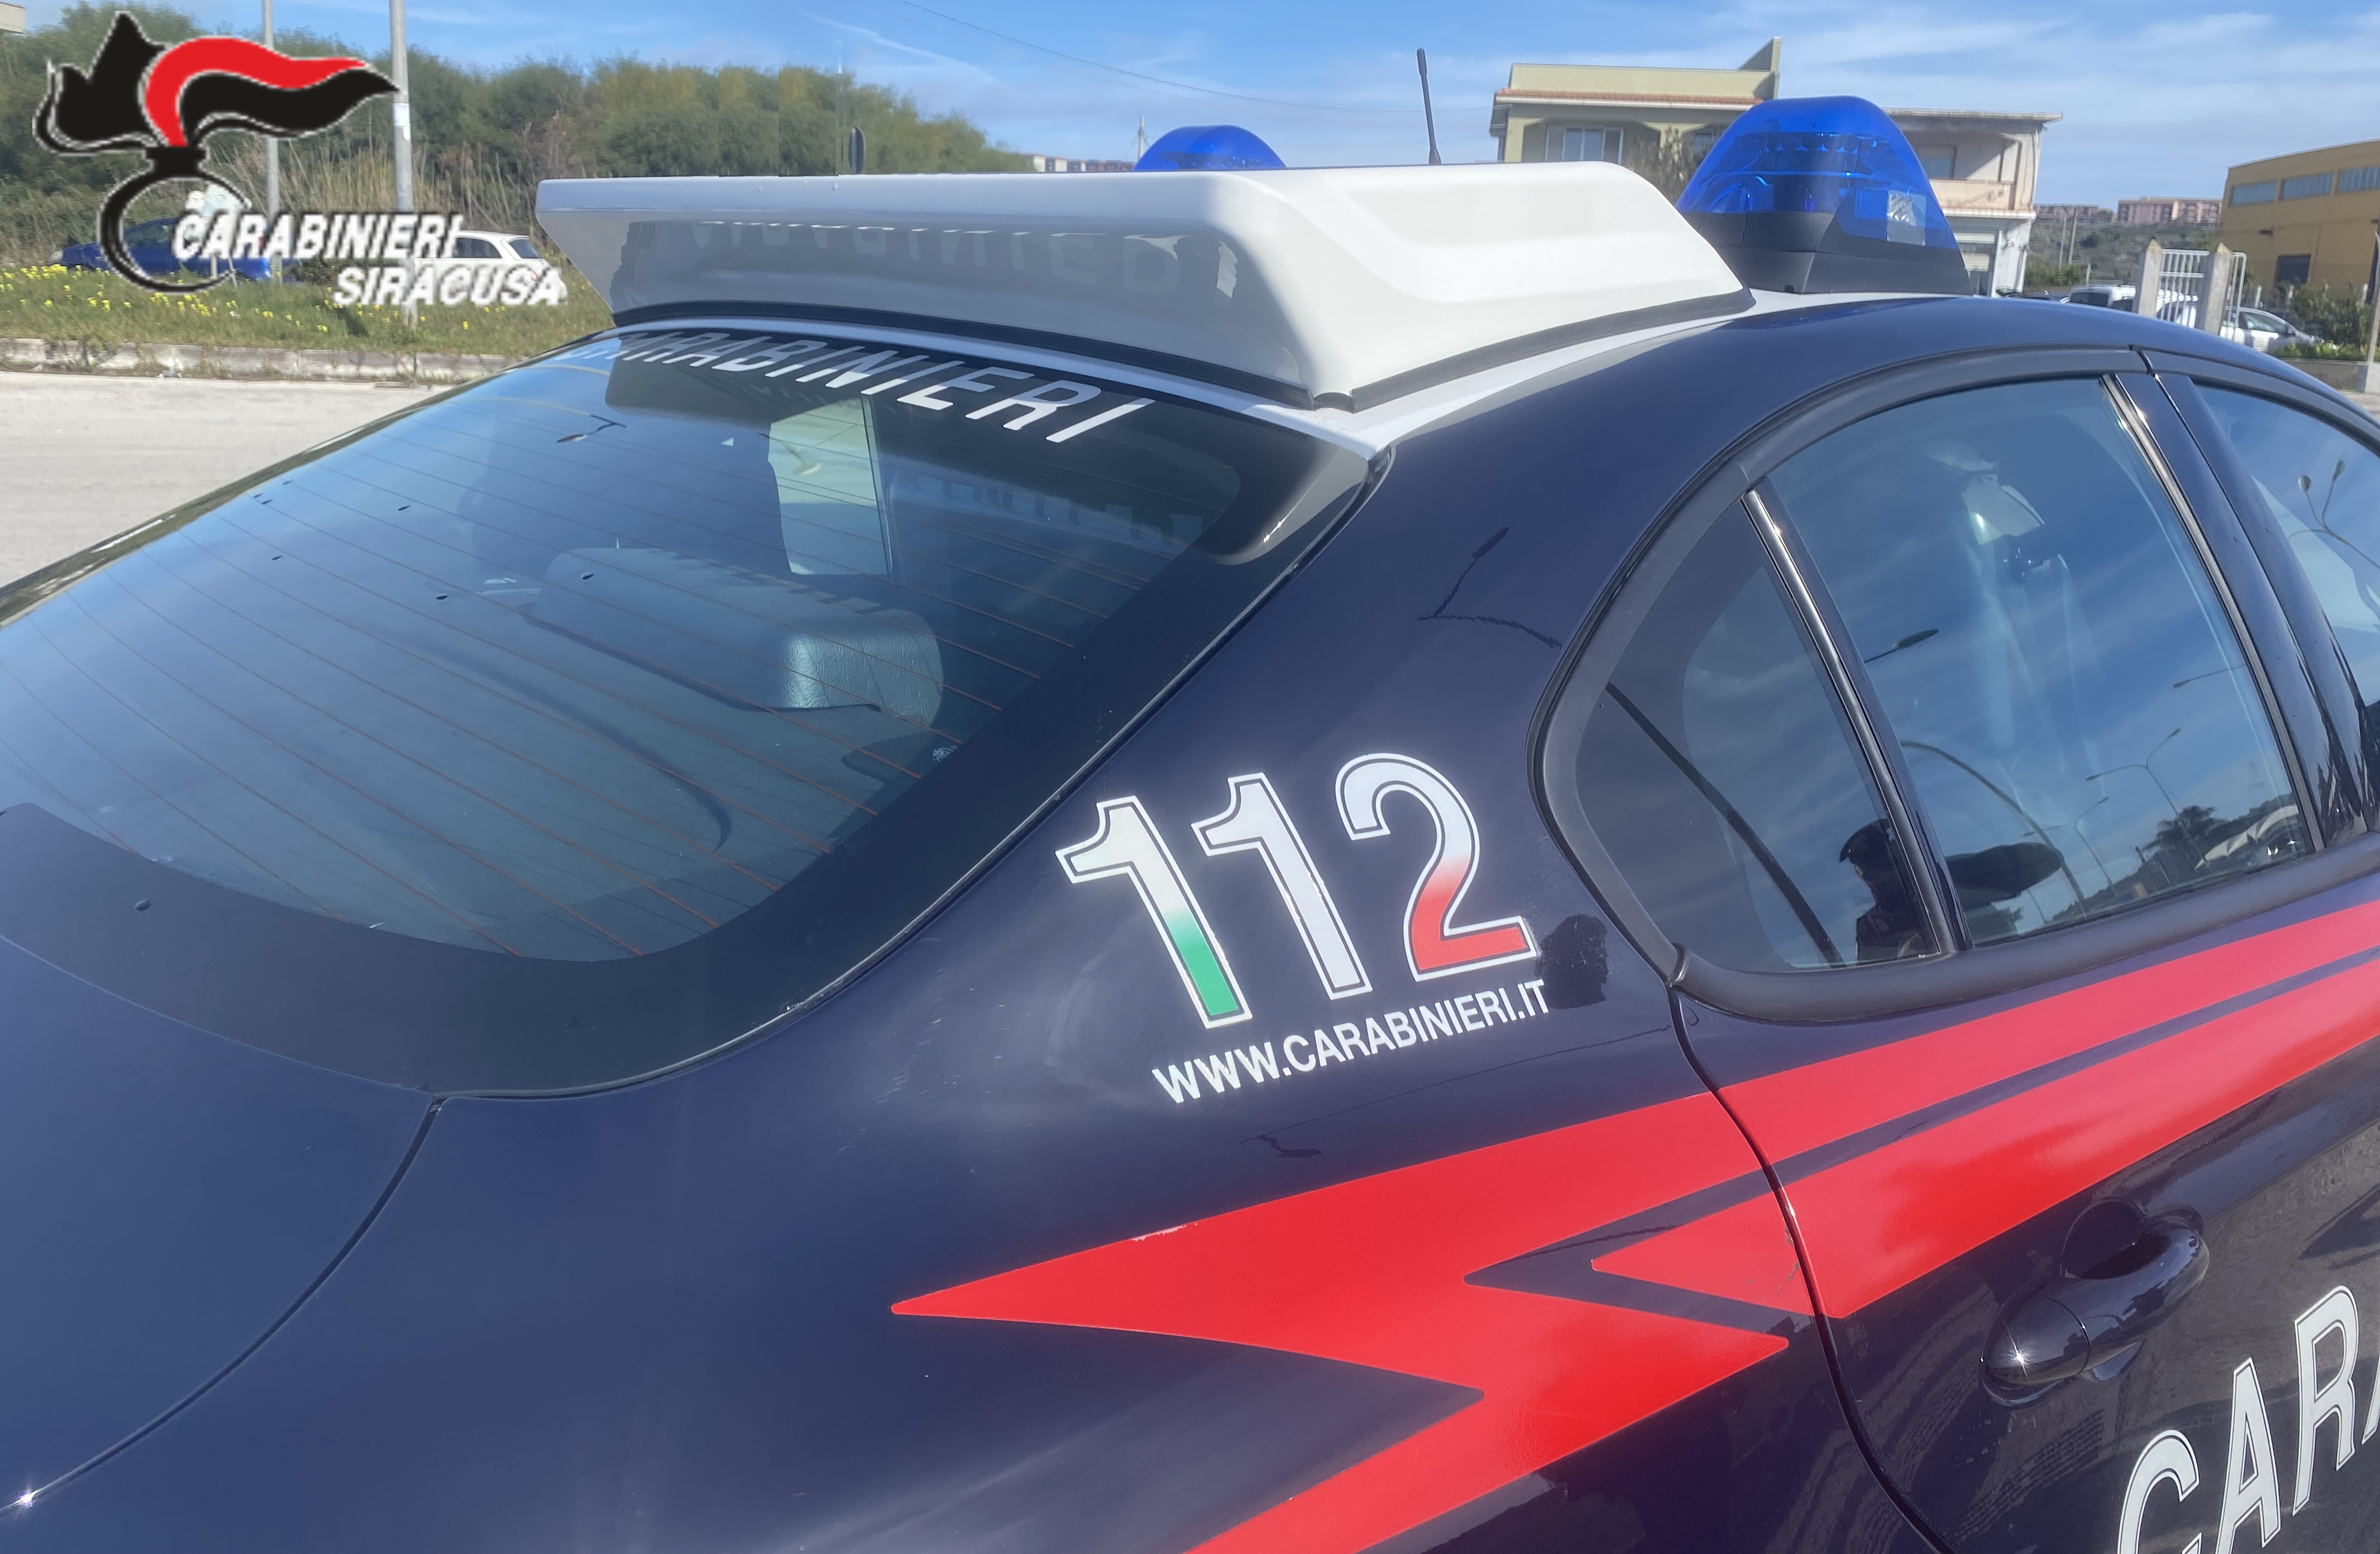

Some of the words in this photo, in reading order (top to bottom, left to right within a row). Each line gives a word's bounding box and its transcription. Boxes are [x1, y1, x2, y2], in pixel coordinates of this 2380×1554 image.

[1055, 752, 1538, 1029] 112
[1152, 979, 1550, 1103] WWW.CARABINIERI.IT
[2117, 1285, 2380, 1554] CAR
